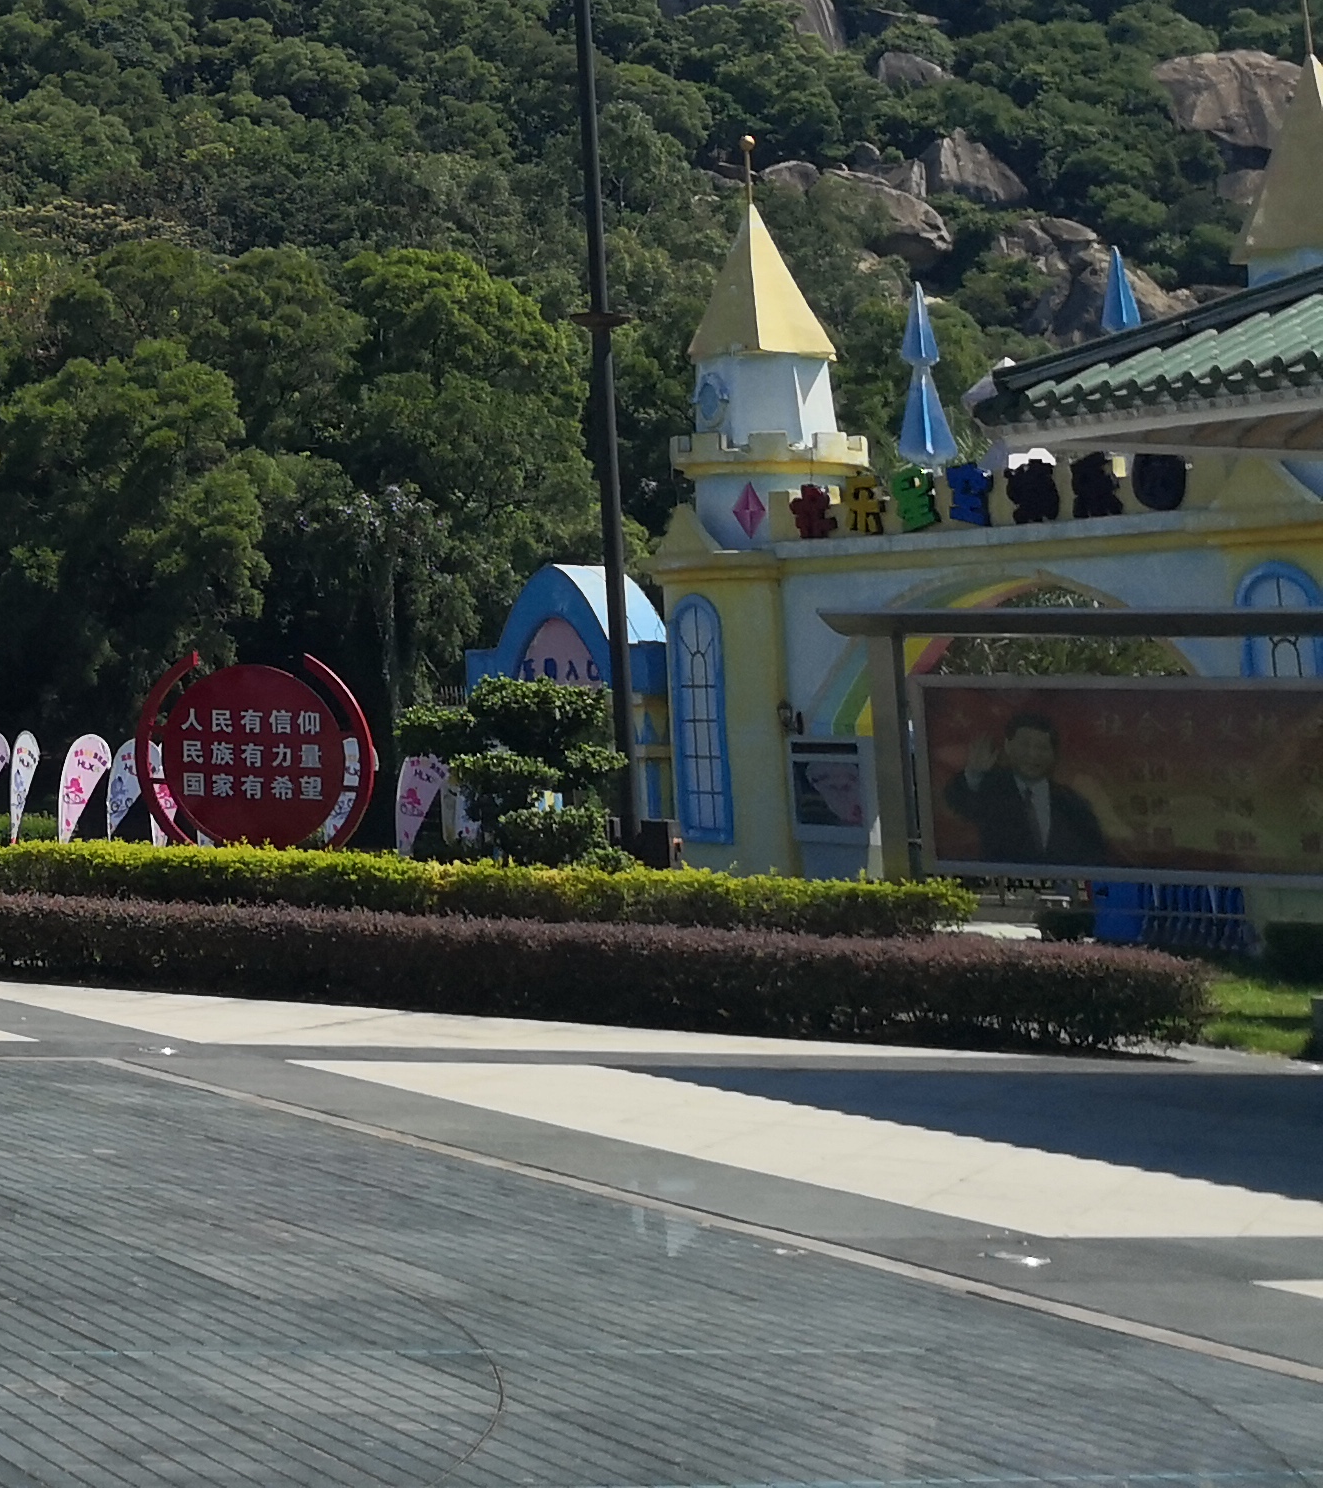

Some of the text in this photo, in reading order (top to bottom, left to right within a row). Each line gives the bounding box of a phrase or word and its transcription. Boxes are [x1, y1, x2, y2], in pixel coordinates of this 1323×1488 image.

[181, 708, 321, 735] 人民有信仰
[182, 741, 322, 769] 民族有力量
[182, 772, 323, 801] 国家有希望
